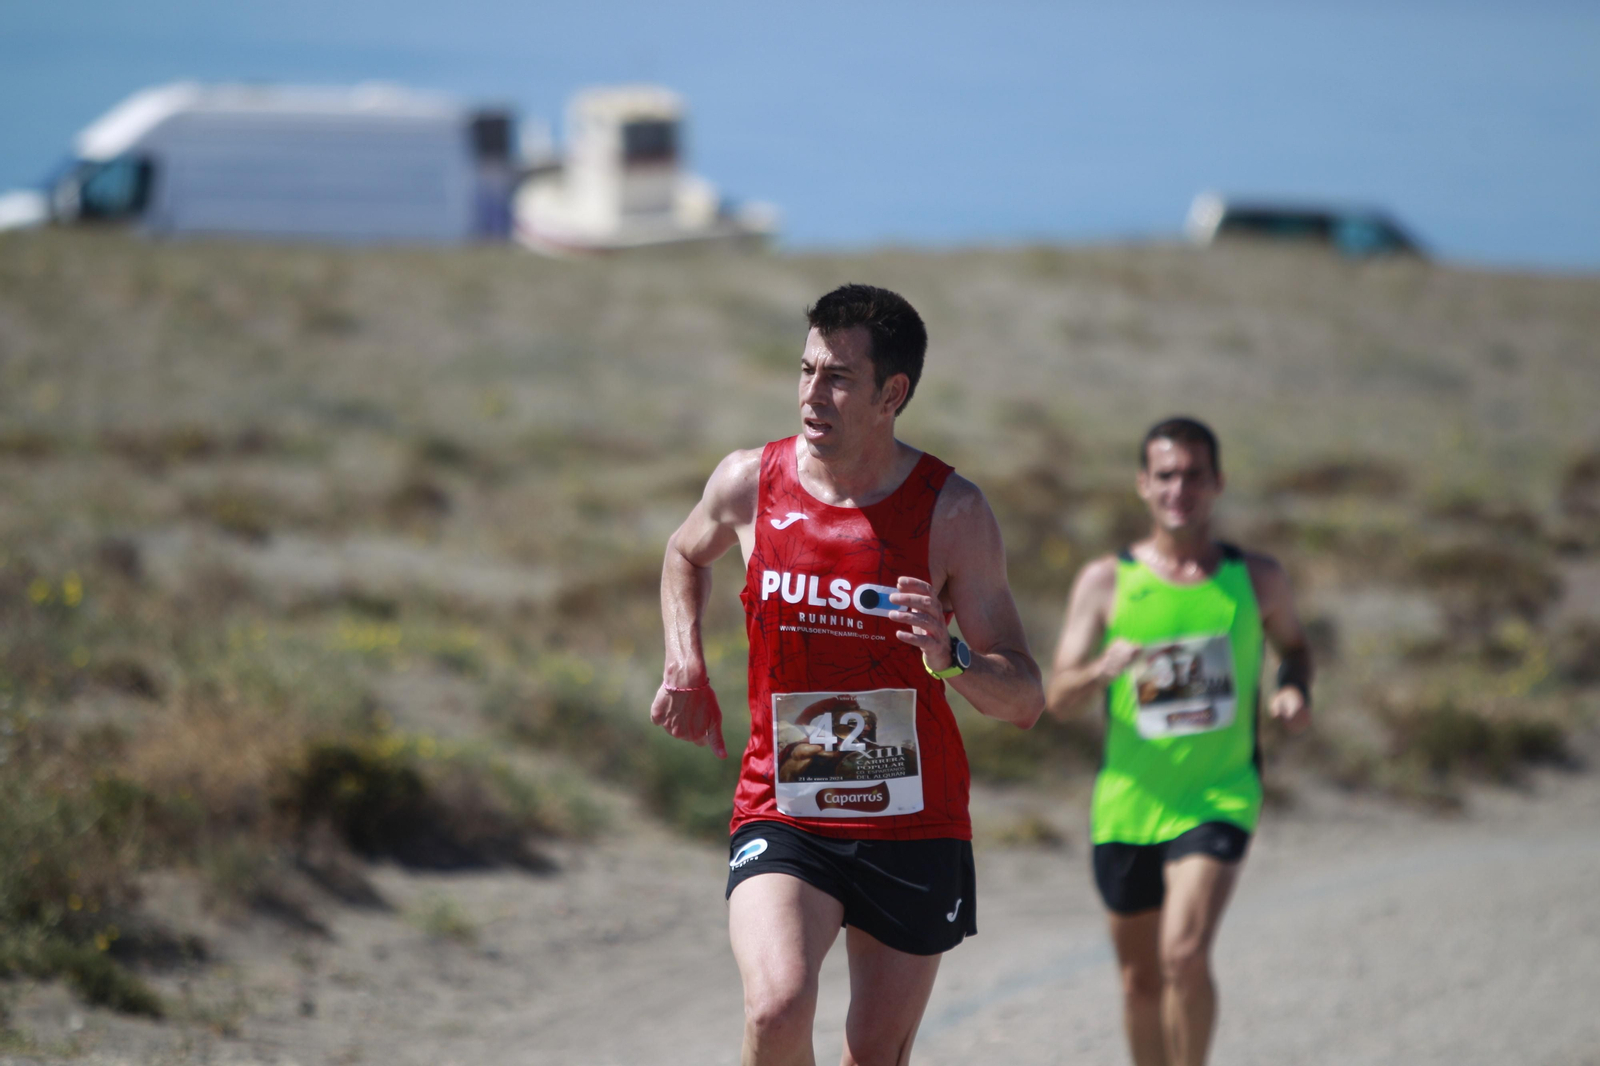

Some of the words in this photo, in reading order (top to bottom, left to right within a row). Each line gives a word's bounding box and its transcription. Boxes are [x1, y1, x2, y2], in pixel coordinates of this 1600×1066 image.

[799, 612, 864, 630] RUNNING
[809, 712, 866, 752] 42
[856, 745, 905, 760] XIII
[856, 756, 905, 766] CARRERA
[856, 762, 905, 771] POPULAR
